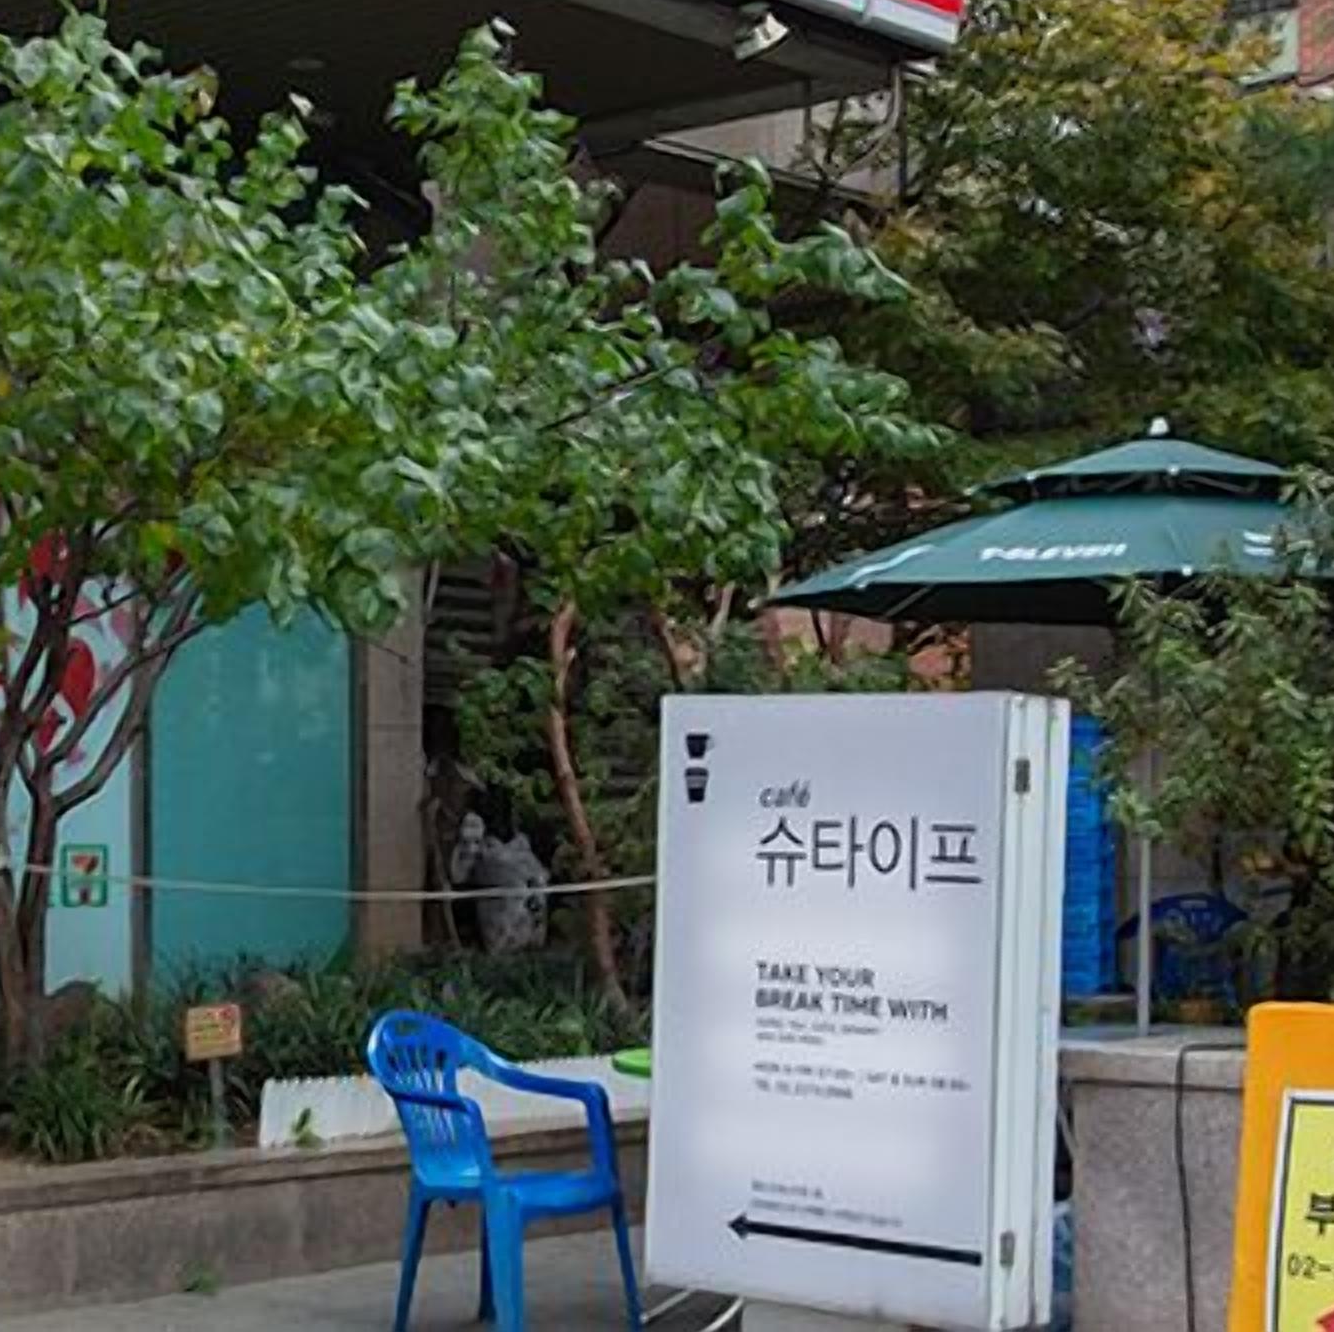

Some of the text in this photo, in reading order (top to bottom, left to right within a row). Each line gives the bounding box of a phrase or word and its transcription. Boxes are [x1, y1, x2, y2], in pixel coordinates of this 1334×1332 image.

[758, 779, 812, 810] café
[755, 814, 983, 891] 슈타이프
[757, 961, 875, 989] TAKE YOUR
[755, 988, 948, 1021] BREAK TIME WITH
